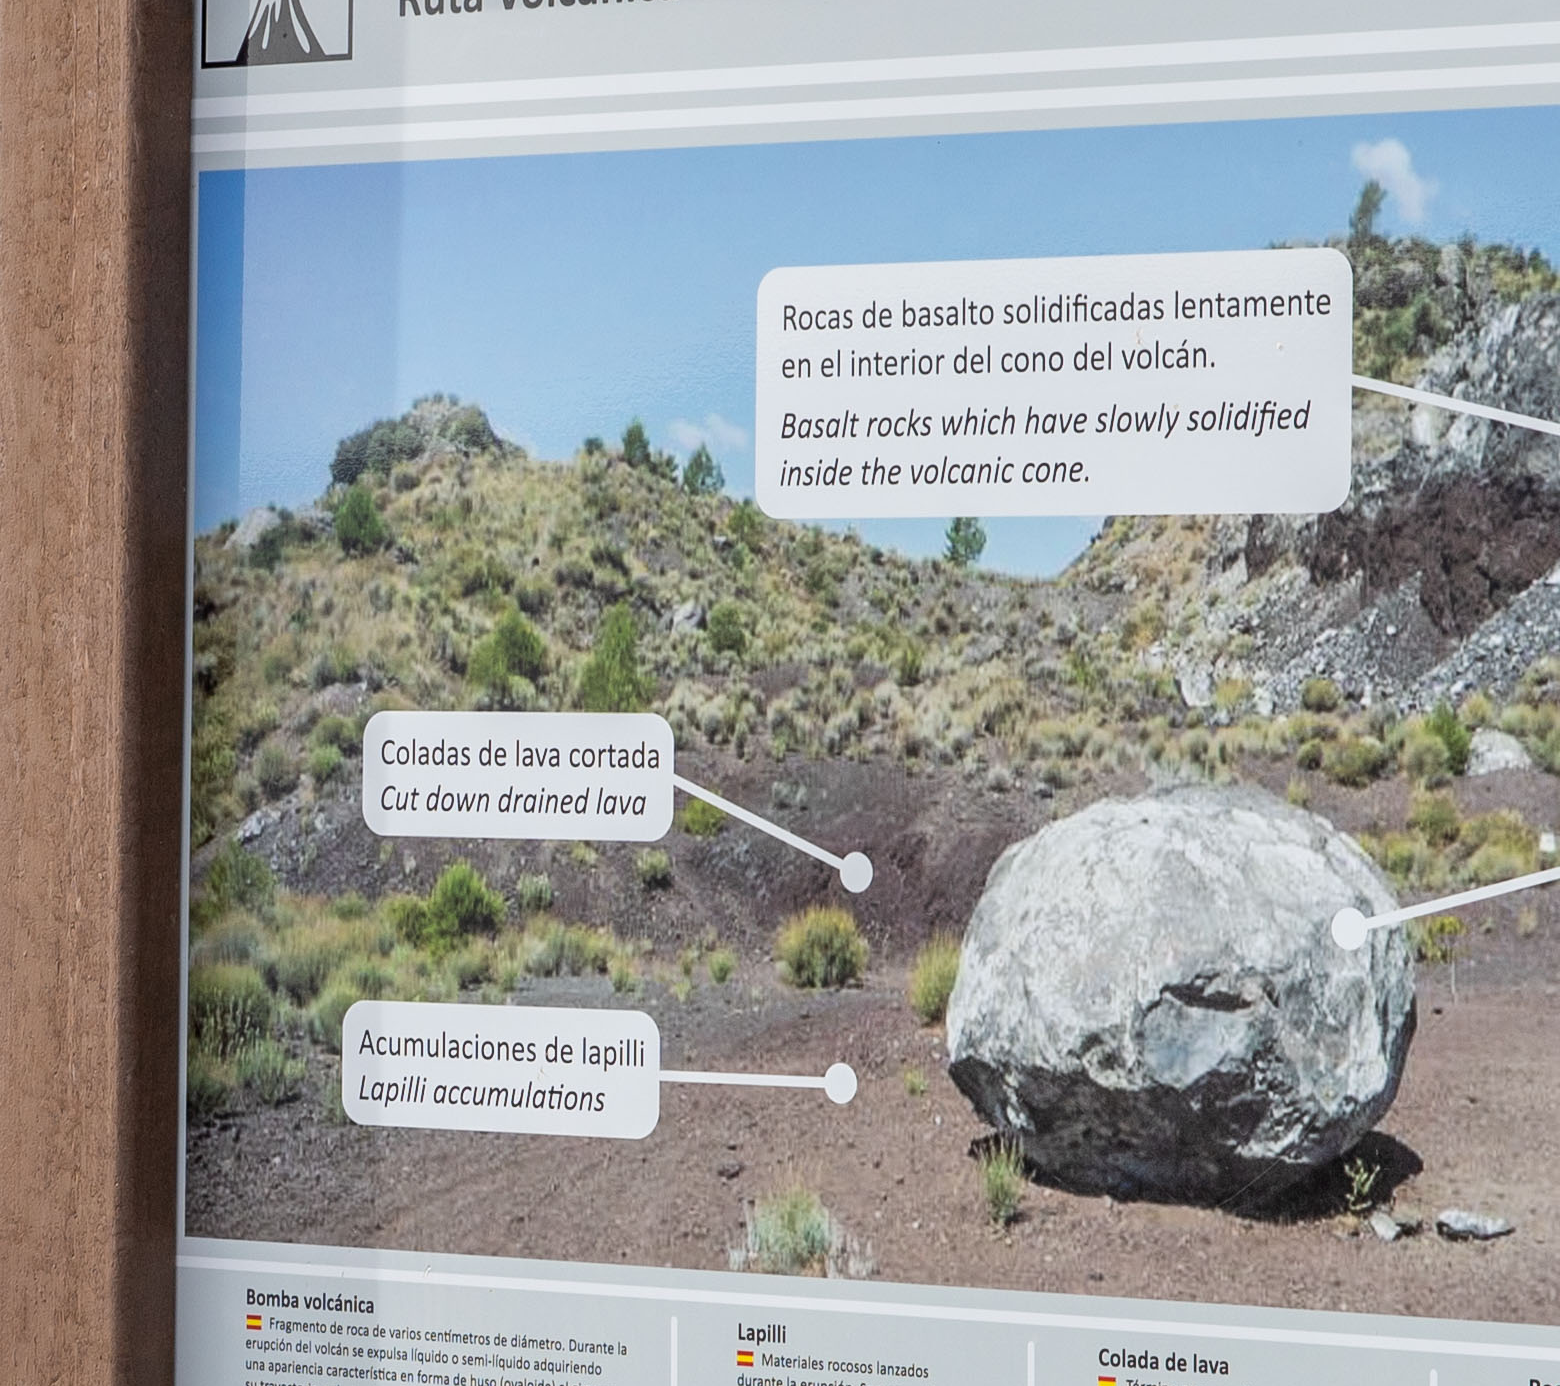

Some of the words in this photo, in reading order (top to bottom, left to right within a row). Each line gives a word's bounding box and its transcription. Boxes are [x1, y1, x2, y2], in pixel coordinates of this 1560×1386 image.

[784, 305, 853, 331] Rocas
[862, 300, 892, 329] de
[902, 297, 994, 327] basalto
[1003, 292, 1164, 324] solidificadas
[1175, 290, 1331, 319] lentamente
[782, 358, 811, 378] en
[821, 349, 840, 377] el
[851, 348, 945, 377] interior
[954, 345, 991, 374] del
[1001, 351, 1064, 373] cono
[1074, 342, 1111, 371] del
[1121, 340, 1215, 370] volcán.
[781, 410, 859, 439] Basalt
[867, 408, 932, 437] rocks
[942, 406, 1015, 436] which
[1025, 406, 1087, 434] have
[1095, 403, 1180, 439] slowly
[1187, 400, 1311, 437] solidified
[780, 458, 852, 486] inside
[862, 457, 901, 485] the
[911, 456, 1014, 484] volcanic
[1022, 462, 1089, 483] cone.
[381, 738, 470, 766] Coladas
[479, 739, 507, 767] de
[516, 739, 560, 767] lava
[569, 741, 659, 769] cortada
[381, 785, 420, 811] Cut
[426, 784, 489, 812] down
[498, 786, 590, 814] drained
[596, 787, 646, 815] lava
[359, 1029, 536, 1062] Acumulaciones
[545, 1036, 573, 1064] de
[583, 1037, 644, 1070] lapilli
[359, 1075, 427, 1108] Lapilli
[433, 1081, 605, 1112] accumulations
[247, 1288, 299, 1308] Bomba
[304, 1293, 374, 1314] volcánica
[269, 1317, 327, 1334] Fragmento
[330, 1321, 343, 1335] de
[346, 1325, 369, 1337] roca
[372, 1324, 386, 1338] de
[389, 1327, 421, 1340] varios
[424, 1329, 490, 1346] centímetros
[494, 1333, 507, 1347] de
[511, 1334, 565, 1351] diámetro.
[569, 1339, 614, 1355] Durante
[618, 1342, 627, 1356] la
[738, 1323, 786, 1346] Lapilli
[762, 1353, 824, 1371] Materiales
[828, 1361, 873, 1374] rocosos
[877, 1361, 929, 1378] lanzados
[1099, 1348, 1159, 1370] Colada
[1165, 1352, 1187, 1372] de
[1193, 1353, 1229, 1375] lava
